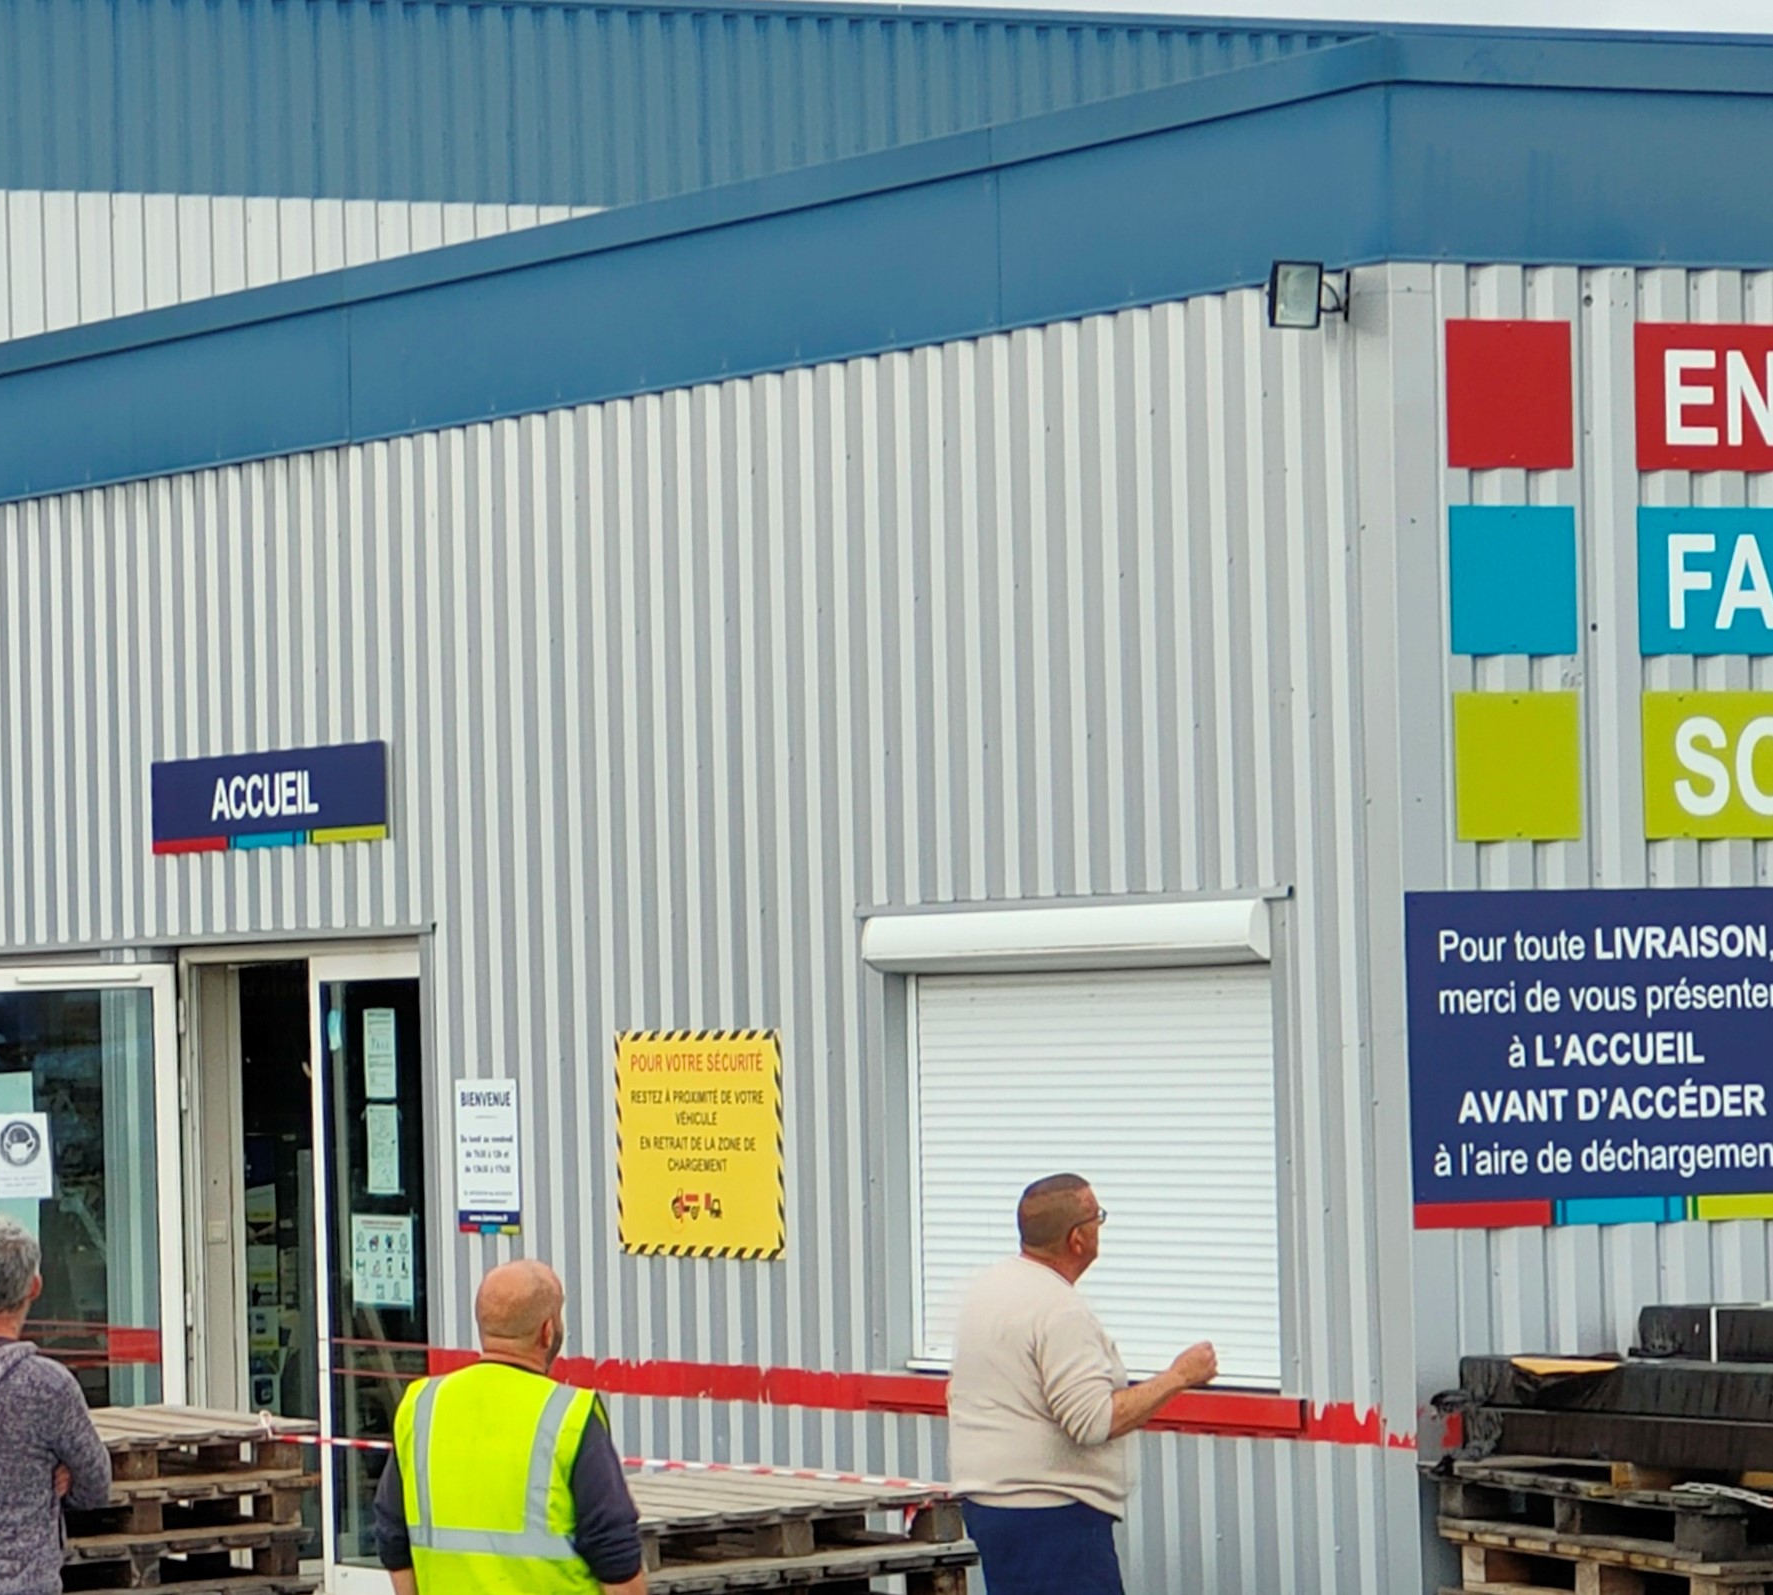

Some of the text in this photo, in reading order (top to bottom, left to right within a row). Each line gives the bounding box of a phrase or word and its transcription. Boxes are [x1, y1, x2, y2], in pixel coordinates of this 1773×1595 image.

[1665, 349, 1773, 446] EN
[1668, 533, 1773, 630] FA
[212, 770, 319, 821] ACCUEIL
[1438, 930, 1506, 962] Pour
[1514, 930, 1585, 961] toute
[1438, 981, 1516, 1014] merci
[1525, 980, 1560, 1013] de
[1569, 984, 1636, 1012] vous
[631, 1050, 763, 1072] POUR VOTRE SÉCURITÉ
[1508, 1032, 1705, 1068] à L'ACCUEIL
[460, 1091, 512, 1107] BIENVENUE
[631, 1087, 764, 1104] RESTEZ À PROXIMITÉ DE VOTRE
[1458, 1078, 1767, 1124] AVANT D'ACCÉDER
[675, 1111, 717, 1125] VÉHICULE
[640, 1136, 756, 1151] EN RETRAIT DE LA ZONE DE
[1434, 1144, 1452, 1177] à
[1537, 1141, 1572, 1174] de
[1581, 1139, 1773, 1178] déchargemen
[667, 1158, 727, 1172] CHARGEMENT
